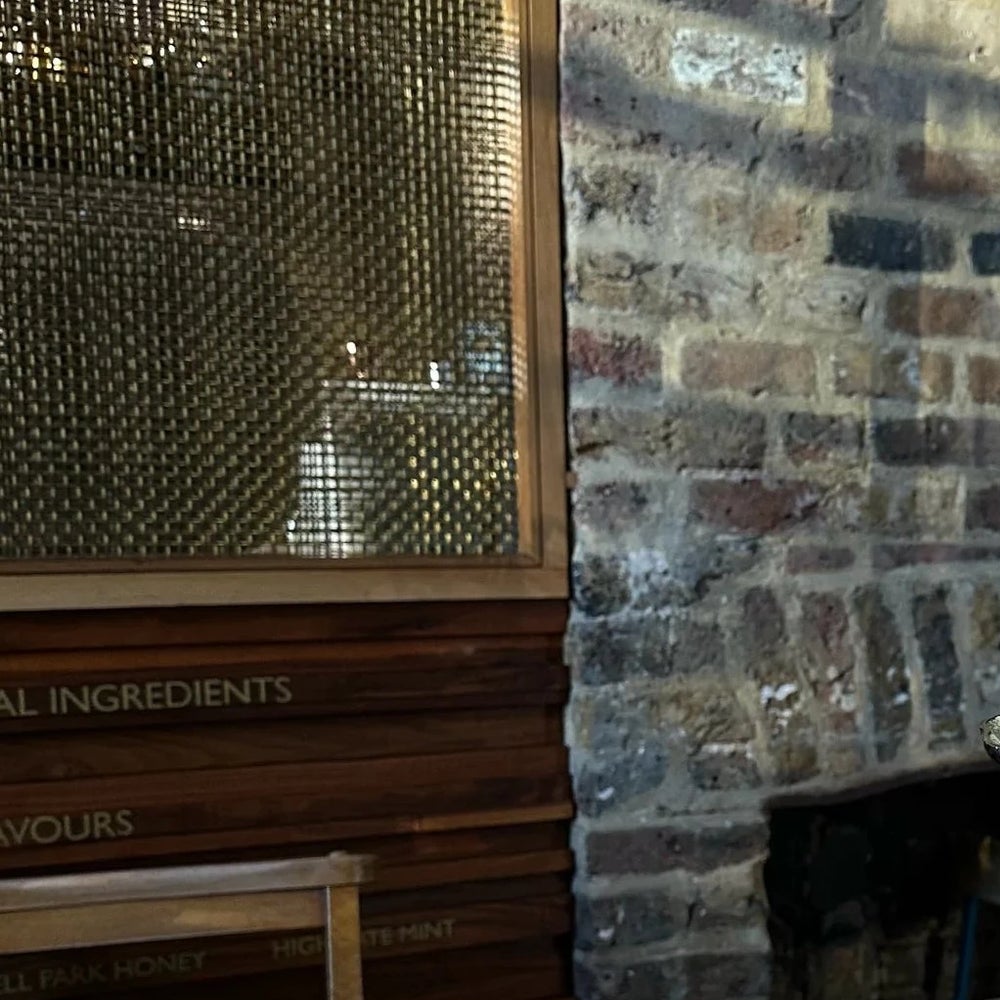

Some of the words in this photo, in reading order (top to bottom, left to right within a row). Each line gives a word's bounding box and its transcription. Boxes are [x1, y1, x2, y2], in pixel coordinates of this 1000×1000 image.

[50, 676, 293, 715] INGREDIENTS
[399, 918, 456, 944] MINT
[39, 963, 108, 993] PARK
[112, 951, 207, 982] HONEY
